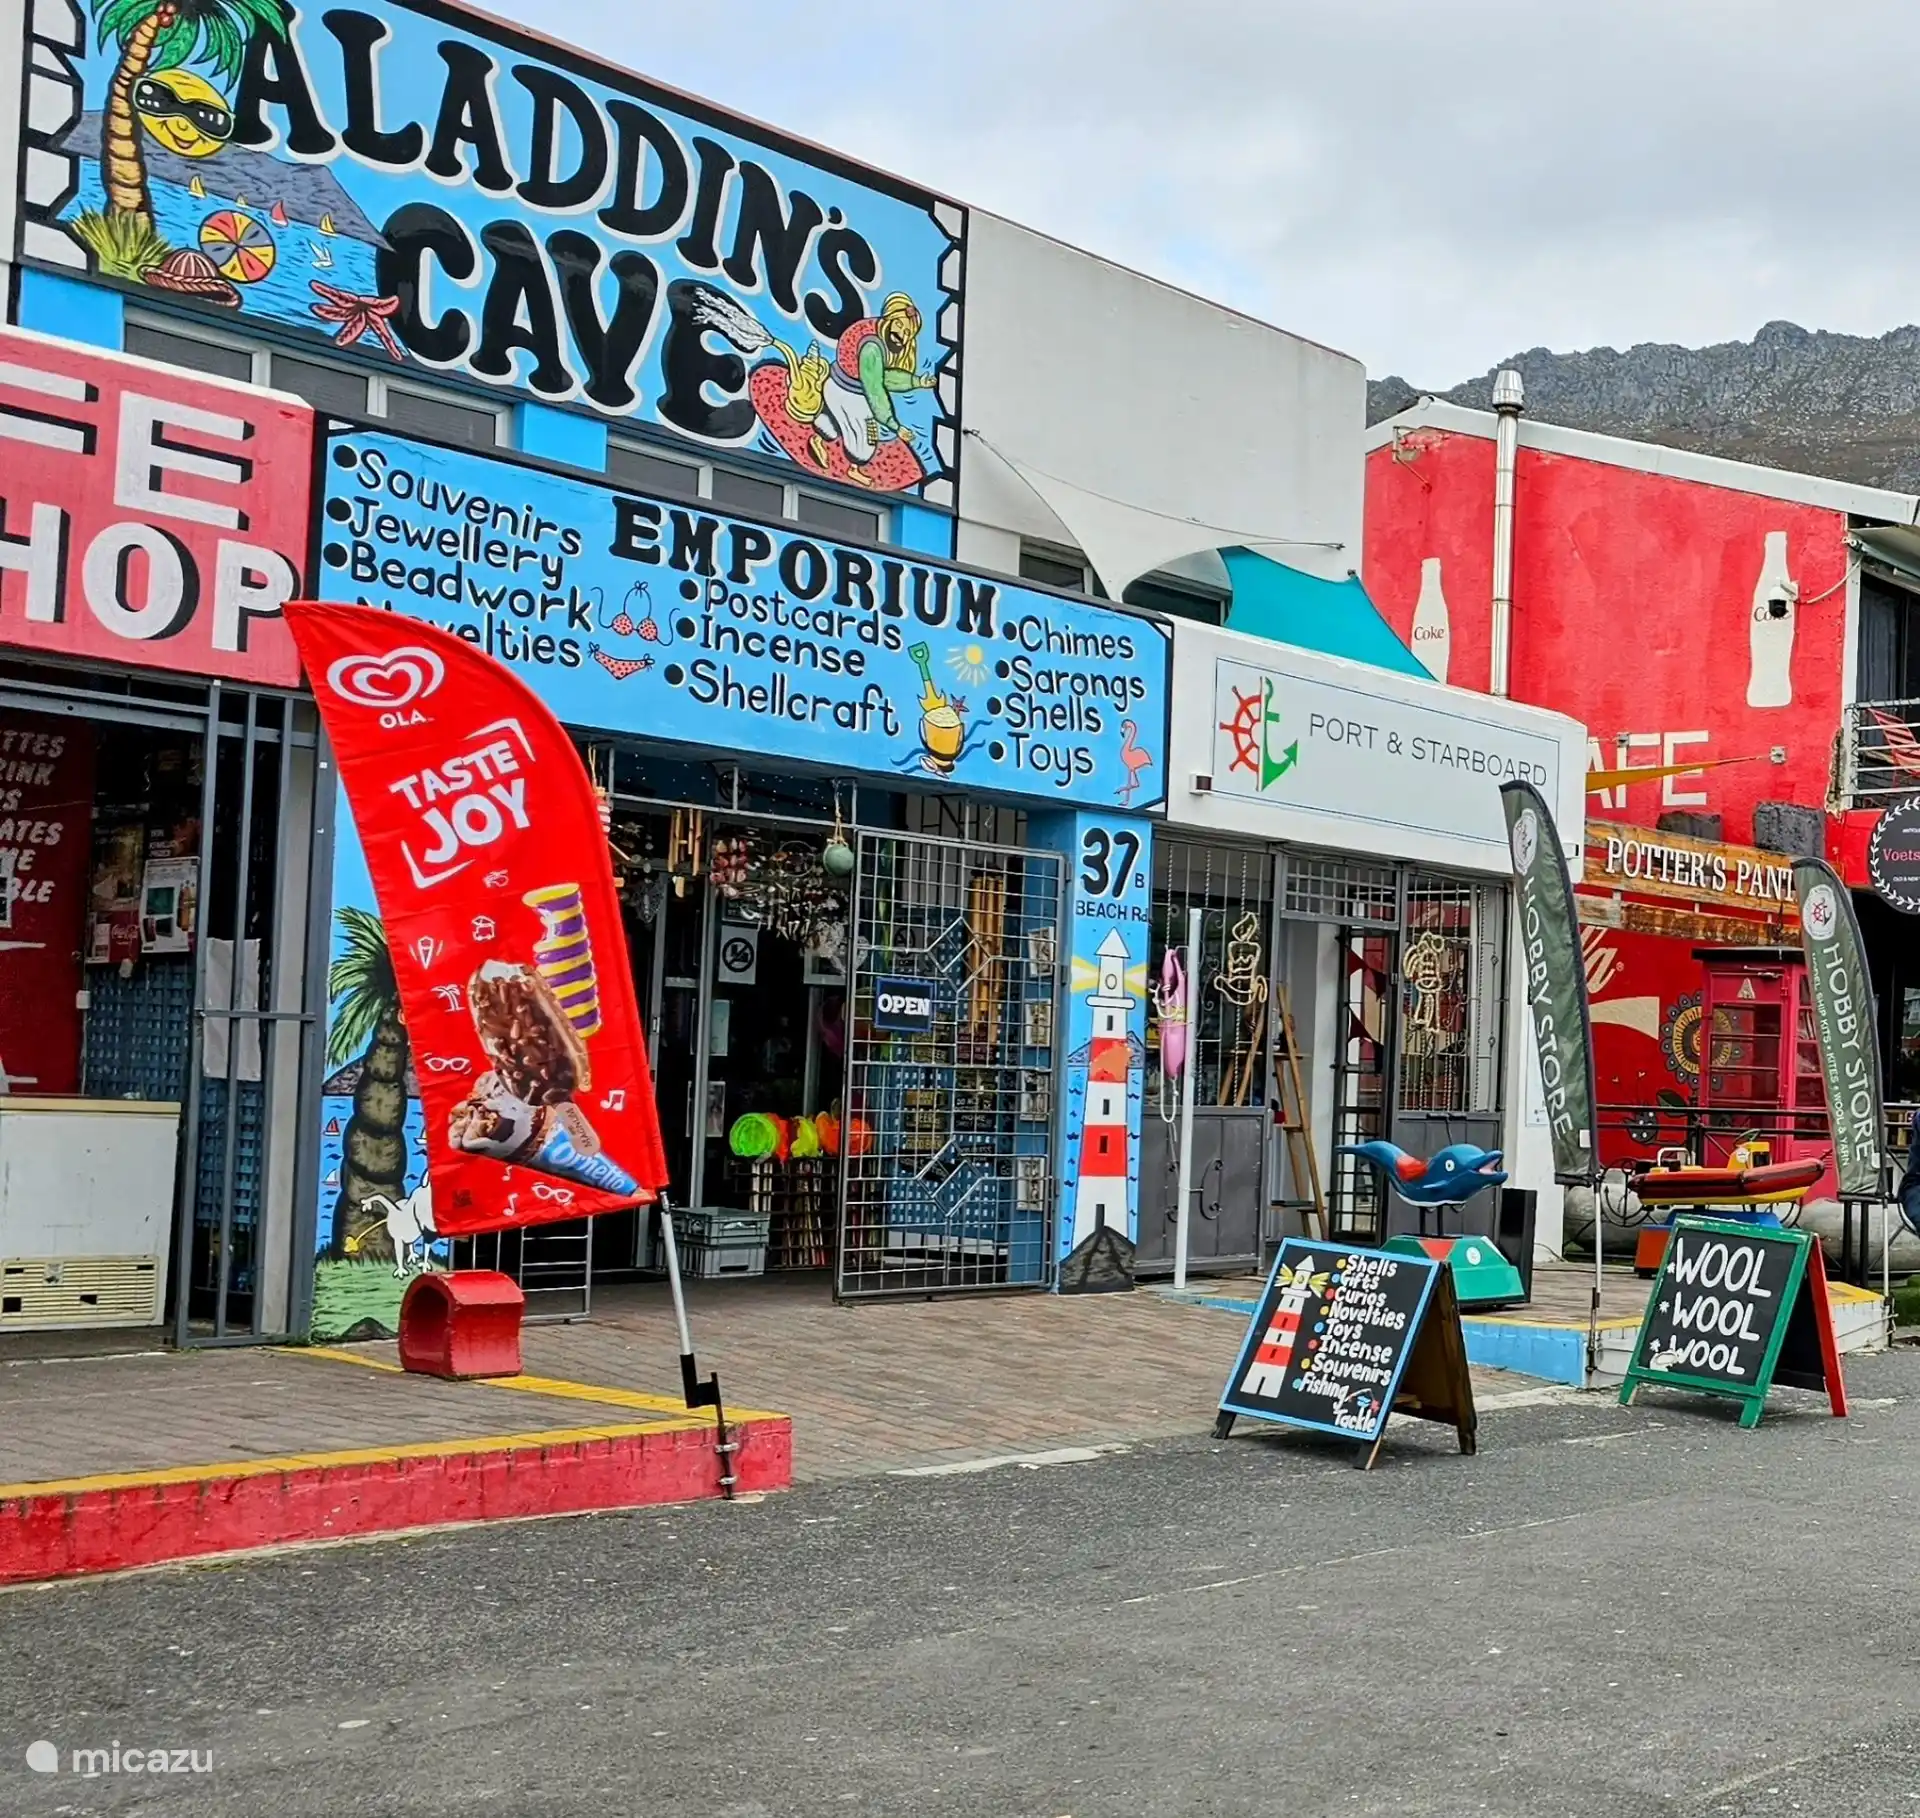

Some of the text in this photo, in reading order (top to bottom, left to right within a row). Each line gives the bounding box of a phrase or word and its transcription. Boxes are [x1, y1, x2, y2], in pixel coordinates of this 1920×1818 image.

[233, 0, 879, 341] ALADDIN'S
[375, 202, 760, 446] CAVE
[356, 448, 582, 556] Souvenirs
[348, 496, 564, 591] Jewellery
[350, 540, 593, 633] Beadwork
[608, 496, 1000, 639] EMPORIUM
[705, 577, 902, 651] Postcards
[1414, 625, 1445, 641] Coke
[1754, 606, 1792, 622] Co
[698, 616, 866, 678] Incense
[1018, 619, 1136, 661] Chimes
[687, 661, 900, 738] Shellcraft
[1011, 657, 1146, 713] Sarongs
[379, 708, 427, 729] OLA
[1003, 694, 1103, 733] Shells
[1003, 736, 1094, 787] Toys
[1309, 712, 1548, 788] PORT & STARBOARD
[388, 739, 521, 810] TASTE
[420, 777, 532, 864] JOY
[1080, 826, 1145, 898] 37 B
[1604, 835, 1727, 892] POTTER'S
[1075, 900, 1128, 921] BEACH
[1524, 876, 1553, 1004] HOBBY
[877, 992, 930, 1018] OPEN
[1815, 992, 1827, 1017] SHIP
[1820, 1018, 1832, 1044] KITS
[1823, 942, 1875, 1162] HOBBY STORE
[1826, 1052, 1840, 1084] KITES
[1536, 1014, 1574, 1140] STORE
[1833, 1091, 1845, 1125] WOOL
[1838, 1126, 1847, 1136] &
[1839, 1136, 1850, 1167] YARN
[1339, 1269, 1380, 1291] Gifts
[1345, 1254, 1398, 1278] Shells
[1674, 1237, 1772, 1298] WOOL
[1328, 1300, 1406, 1330] Novelties
[1334, 1286, 1387, 1308] Curios
[1671, 1291, 1760, 1342] WOOL
[1318, 1334, 1393, 1364] Incense
[1325, 1318, 1364, 1342] Toys
[1311, 1352, 1393, 1387] Souvenirs
[1669, 1334, 1746, 1375] WOOL
[1298, 1371, 1350, 1411] Fishing
[1332, 1406, 1377, 1433] Tackle
